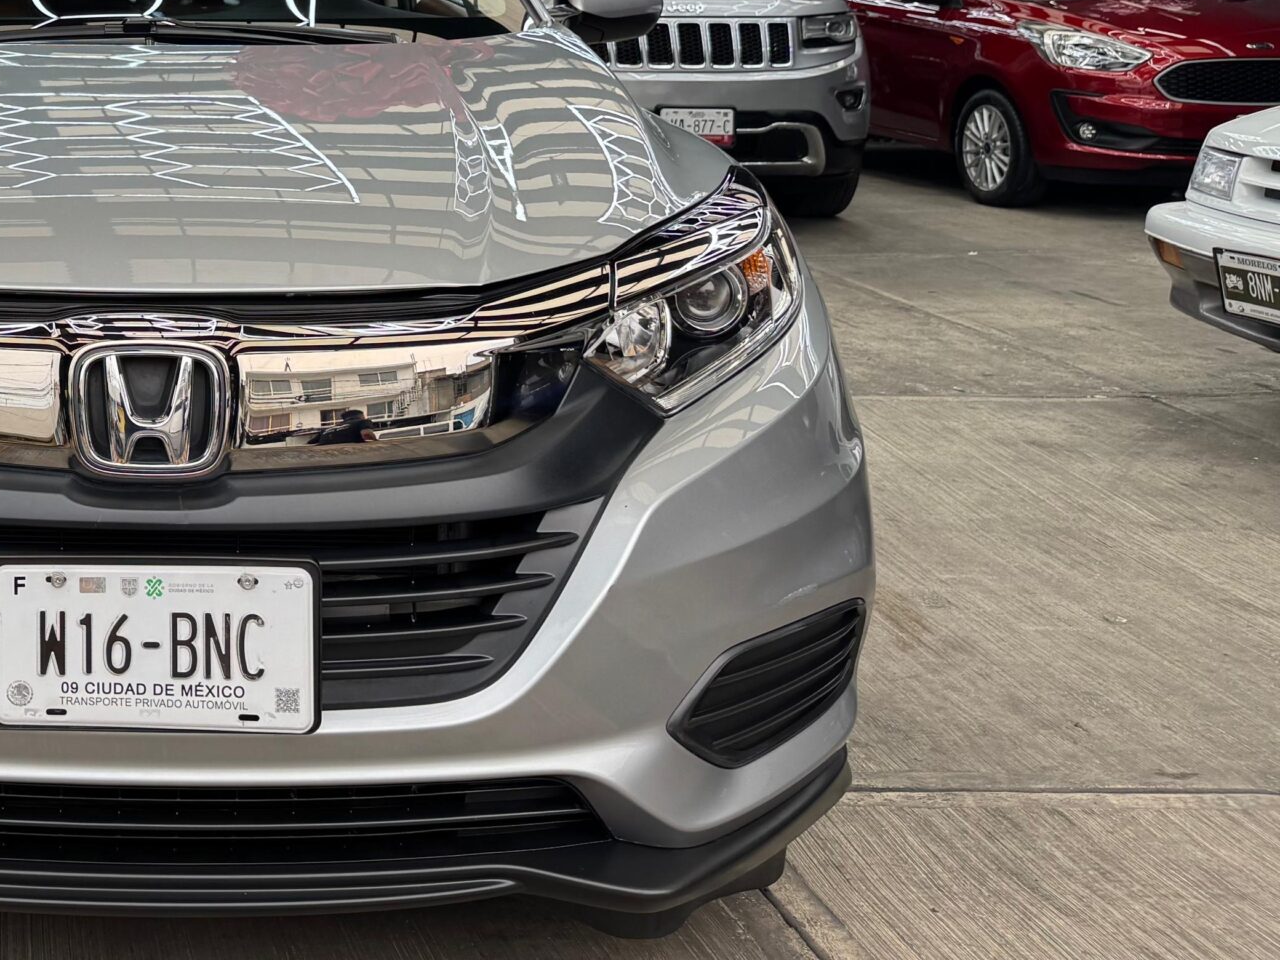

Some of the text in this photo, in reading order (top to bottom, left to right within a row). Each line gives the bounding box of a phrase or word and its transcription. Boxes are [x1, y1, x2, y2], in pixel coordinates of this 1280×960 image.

[666, 1, 704, 14] Jeep
[1237, 257, 1278, 271] MORELOS
[14, 576, 26, 595] F
[37, 610, 265, 680] W16-BNC
[61, 681, 245, 699] 09 CIUDAD DE MÉXICO
[60, 696, 248, 711] TRANSPORTE PRIVADO AUTOMÓVIL
